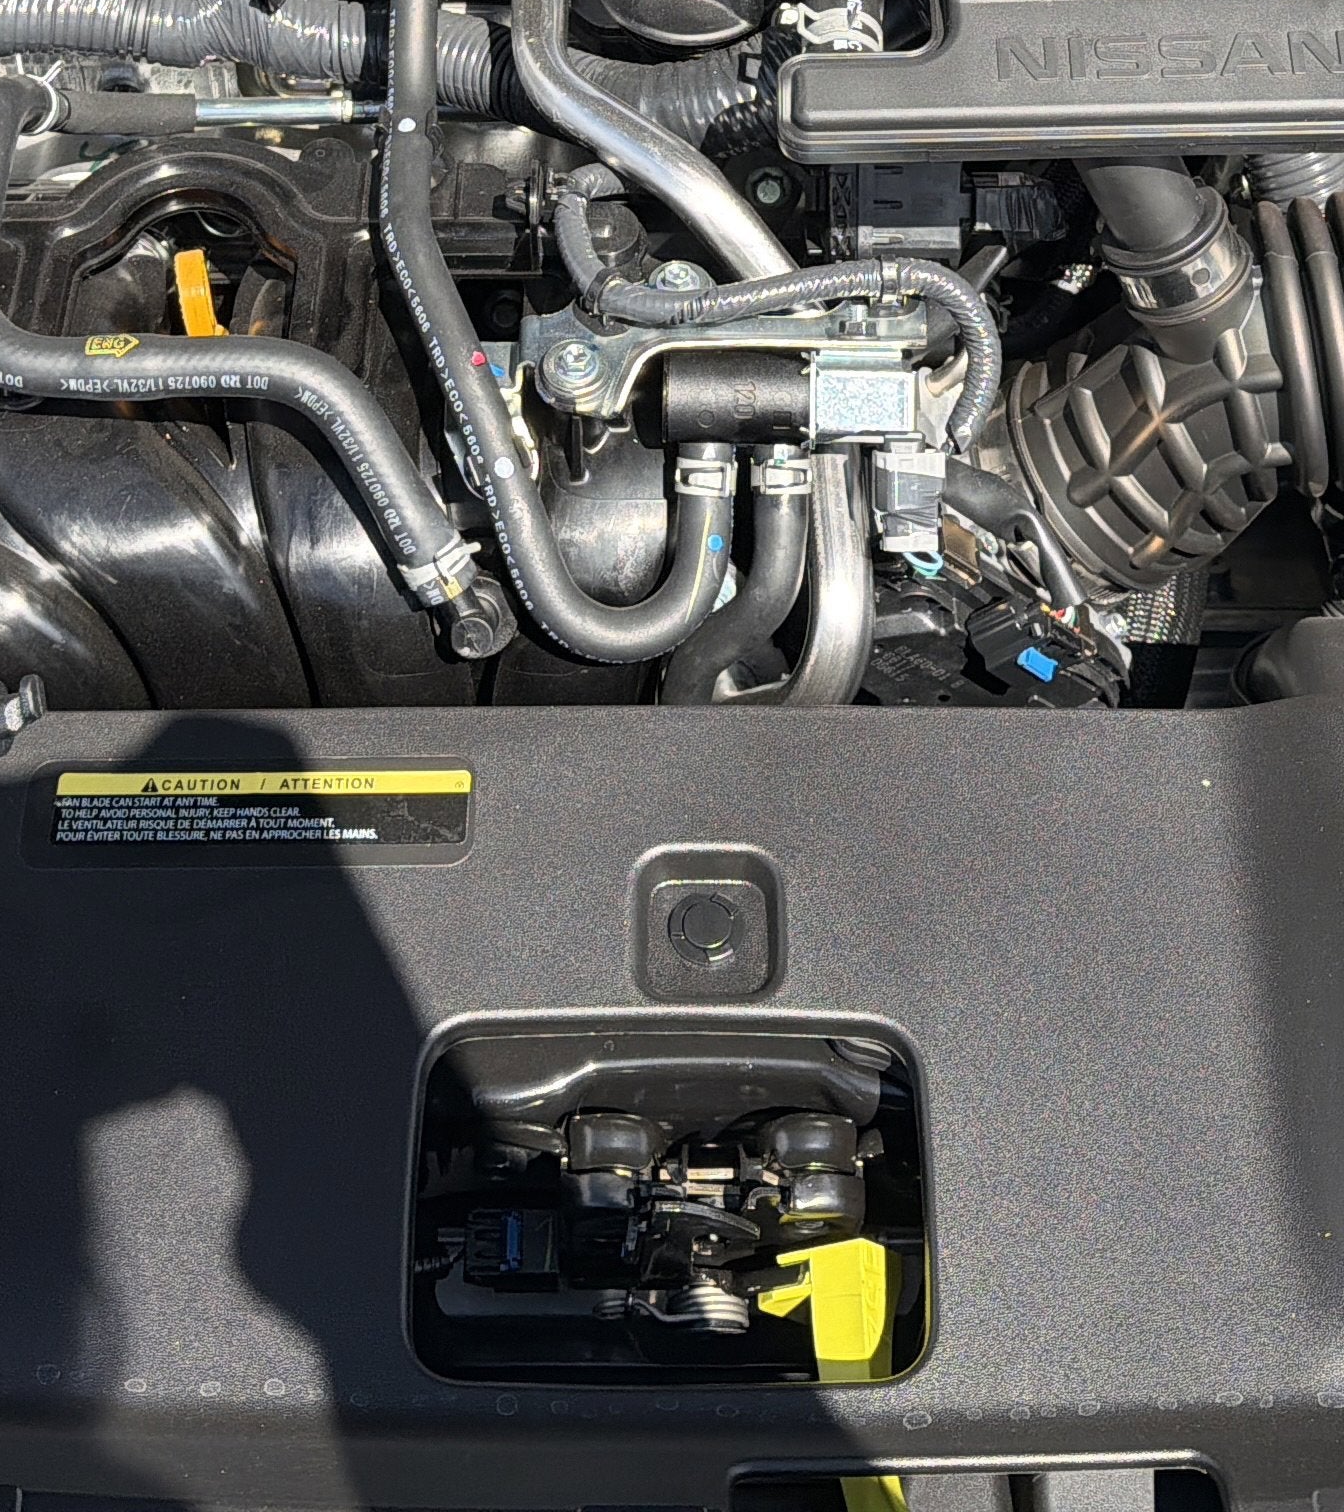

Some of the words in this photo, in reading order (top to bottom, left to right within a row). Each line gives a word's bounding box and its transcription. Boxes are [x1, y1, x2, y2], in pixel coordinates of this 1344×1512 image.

[167, 375, 217, 389] 090725
[246, 376, 269, 391] DOT
[357, 462, 390, 507] 090725
[395, 534, 417, 556] DOT
[161, 778, 241, 791] CAUTION
[279, 777, 375, 790] ATTENTION
[61, 797, 80, 807] FAN
[81, 797, 111, 807] BLADE
[112, 797, 133, 807] CAN
[133, 797, 161, 807] START
[162, 797, 174, 806] AT
[175, 797, 195, 806] ANY
[196, 797, 220, 806] TIME.
[61, 809, 76, 818] TO
[77, 809, 98, 818] HELP
[99, 809, 129, 818] AVOID
[129, 808, 177, 818] PERSONAL
[178, 808, 211, 819] INJURY,
[213, 808, 235, 817] KEEP
[236, 807, 269, 816] HANDS
[270, 807, 300, 816] CLEAR.
[58, 820, 70, 830] LE
[71, 820, 137, 829] VENTILATEUR
[139, 819, 176, 830] RISQUE
[177, 819, 192, 829] DE
[193, 817, 248, 829] DÉMARRER
[249, 817, 257, 828] À
[258, 819, 286, 828] TOUT
[287, 818, 335, 828] MOMENT.
[56, 831, 86, 842] POUR
[87, 829, 120, 841] ÉVITER
[122, 831, 155, 841] TOUTE
[156, 831, 208, 842] BLESSURE,
[209, 830, 224, 840] NE
[225, 830, 244, 840] PAS
[245, 830, 259, 839] EN
[261, 829, 322, 839] APPROCHER
[323, 828, 341, 839] LES
[342, 828, 378, 839] MAINS.
